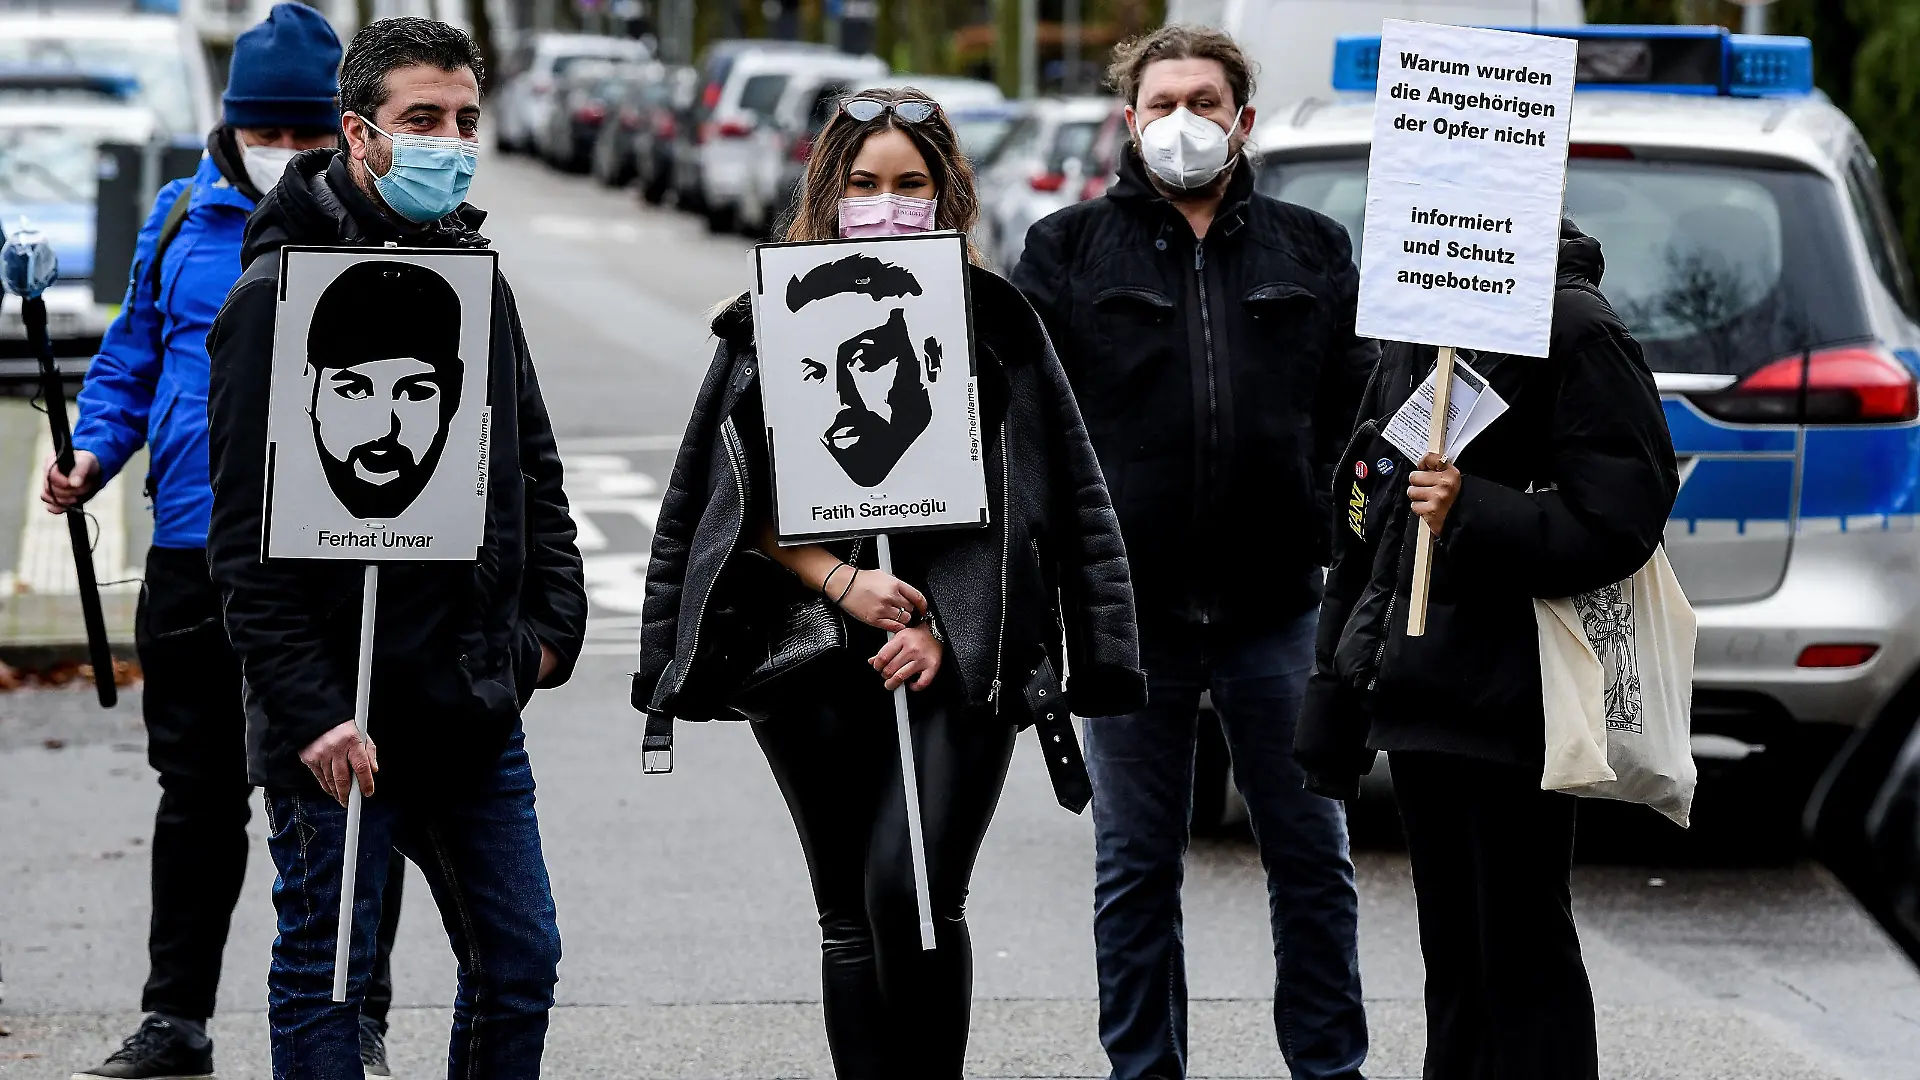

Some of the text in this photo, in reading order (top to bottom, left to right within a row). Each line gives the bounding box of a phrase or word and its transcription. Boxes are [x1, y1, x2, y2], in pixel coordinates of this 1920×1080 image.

[1400, 52, 1552, 86] Warum wurden
[1391, 83, 1555, 118] die Angehörigen
[1394, 114, 1546, 147] der Opfer nicht
[1411, 207, 1512, 233] informiert
[1403, 240, 1515, 264] und Schutz
[1397, 270, 1516, 295] angeboten?
[966, 382, 980, 461] #SayTheirNames
[476, 412, 489, 497] #SayTheirNames
[811, 499, 947, 521] Fatih Saraçoğlu
[318, 531, 433, 548] Ferhat Unvar
